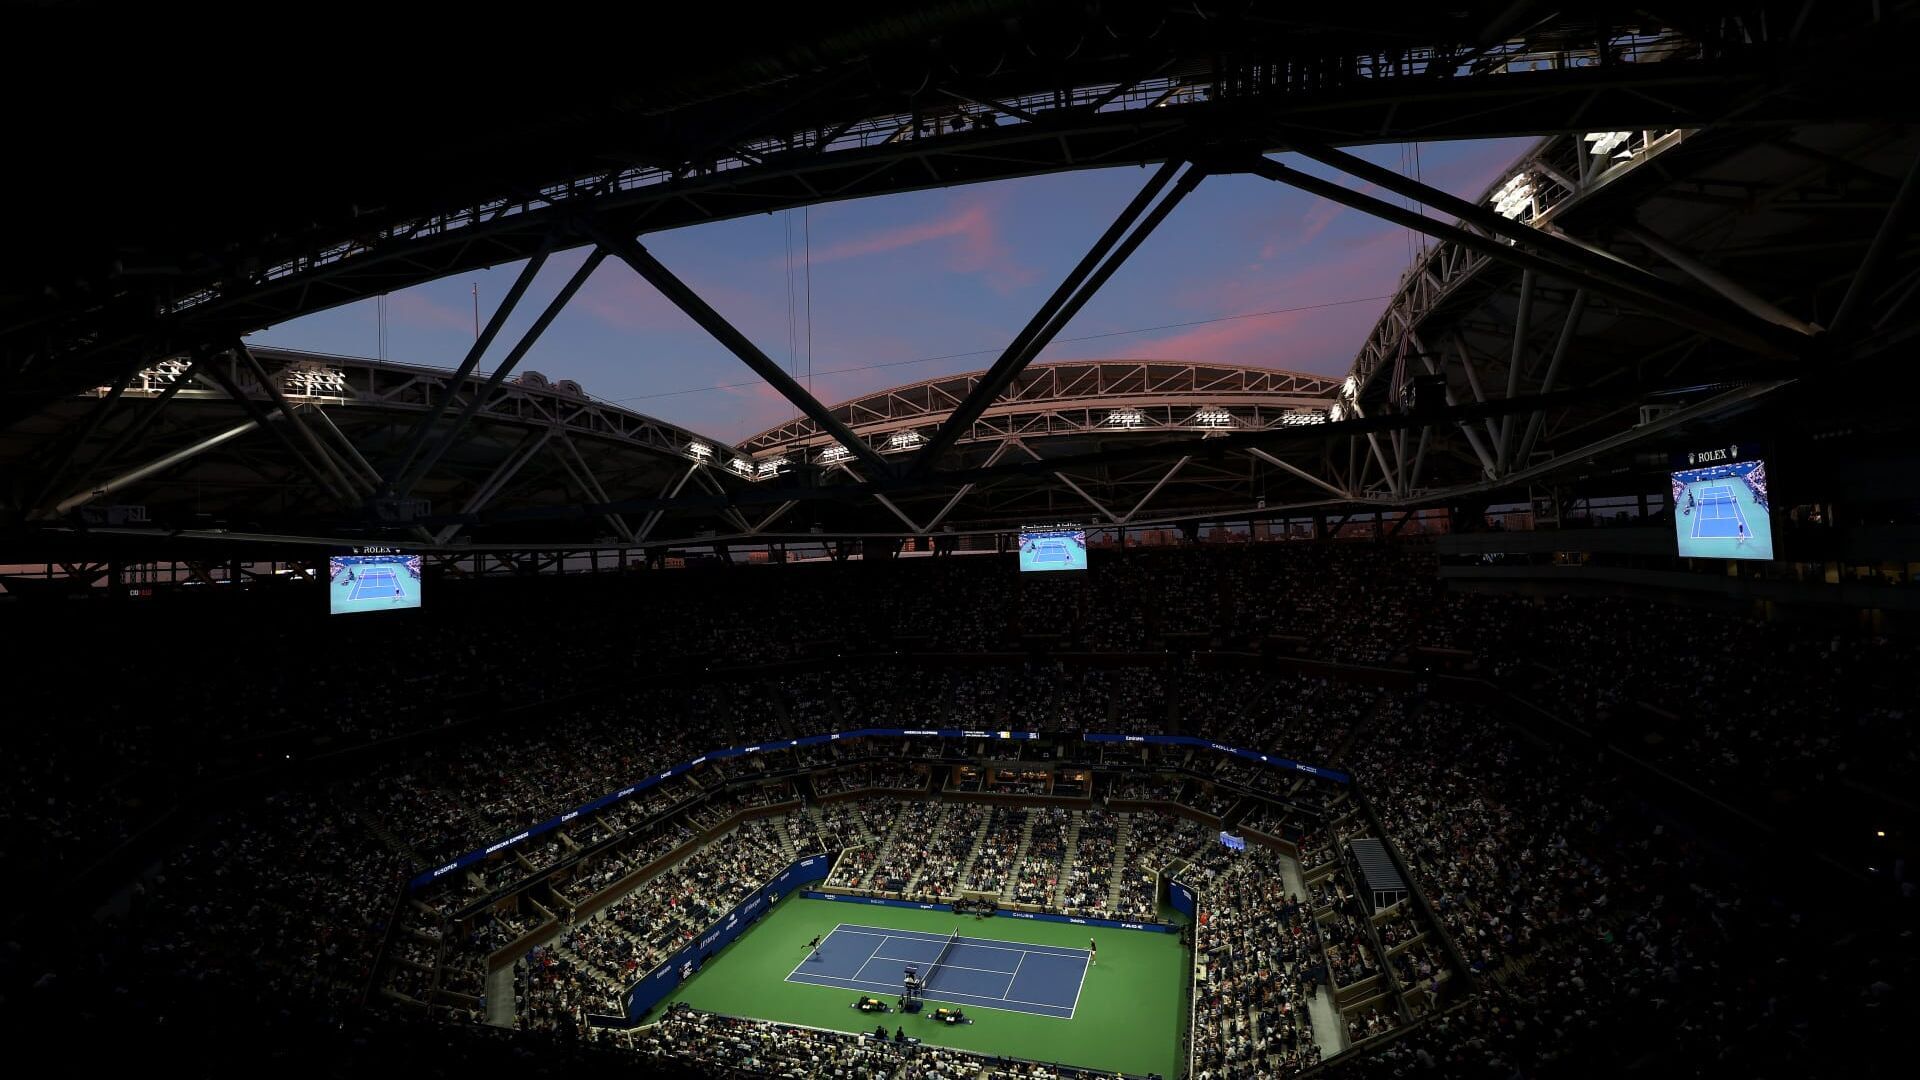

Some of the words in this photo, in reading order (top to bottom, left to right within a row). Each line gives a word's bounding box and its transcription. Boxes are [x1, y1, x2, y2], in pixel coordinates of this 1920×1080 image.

[1698, 448, 1727, 463] ROLEX
[363, 546, 391, 554] ROLEX
[1211, 743, 1238, 754] CADILLAC
[485, 839, 510, 854] AMERICAN
[509, 831, 529, 846] EXPRESS
[433, 862, 458, 877] #USOPEN
